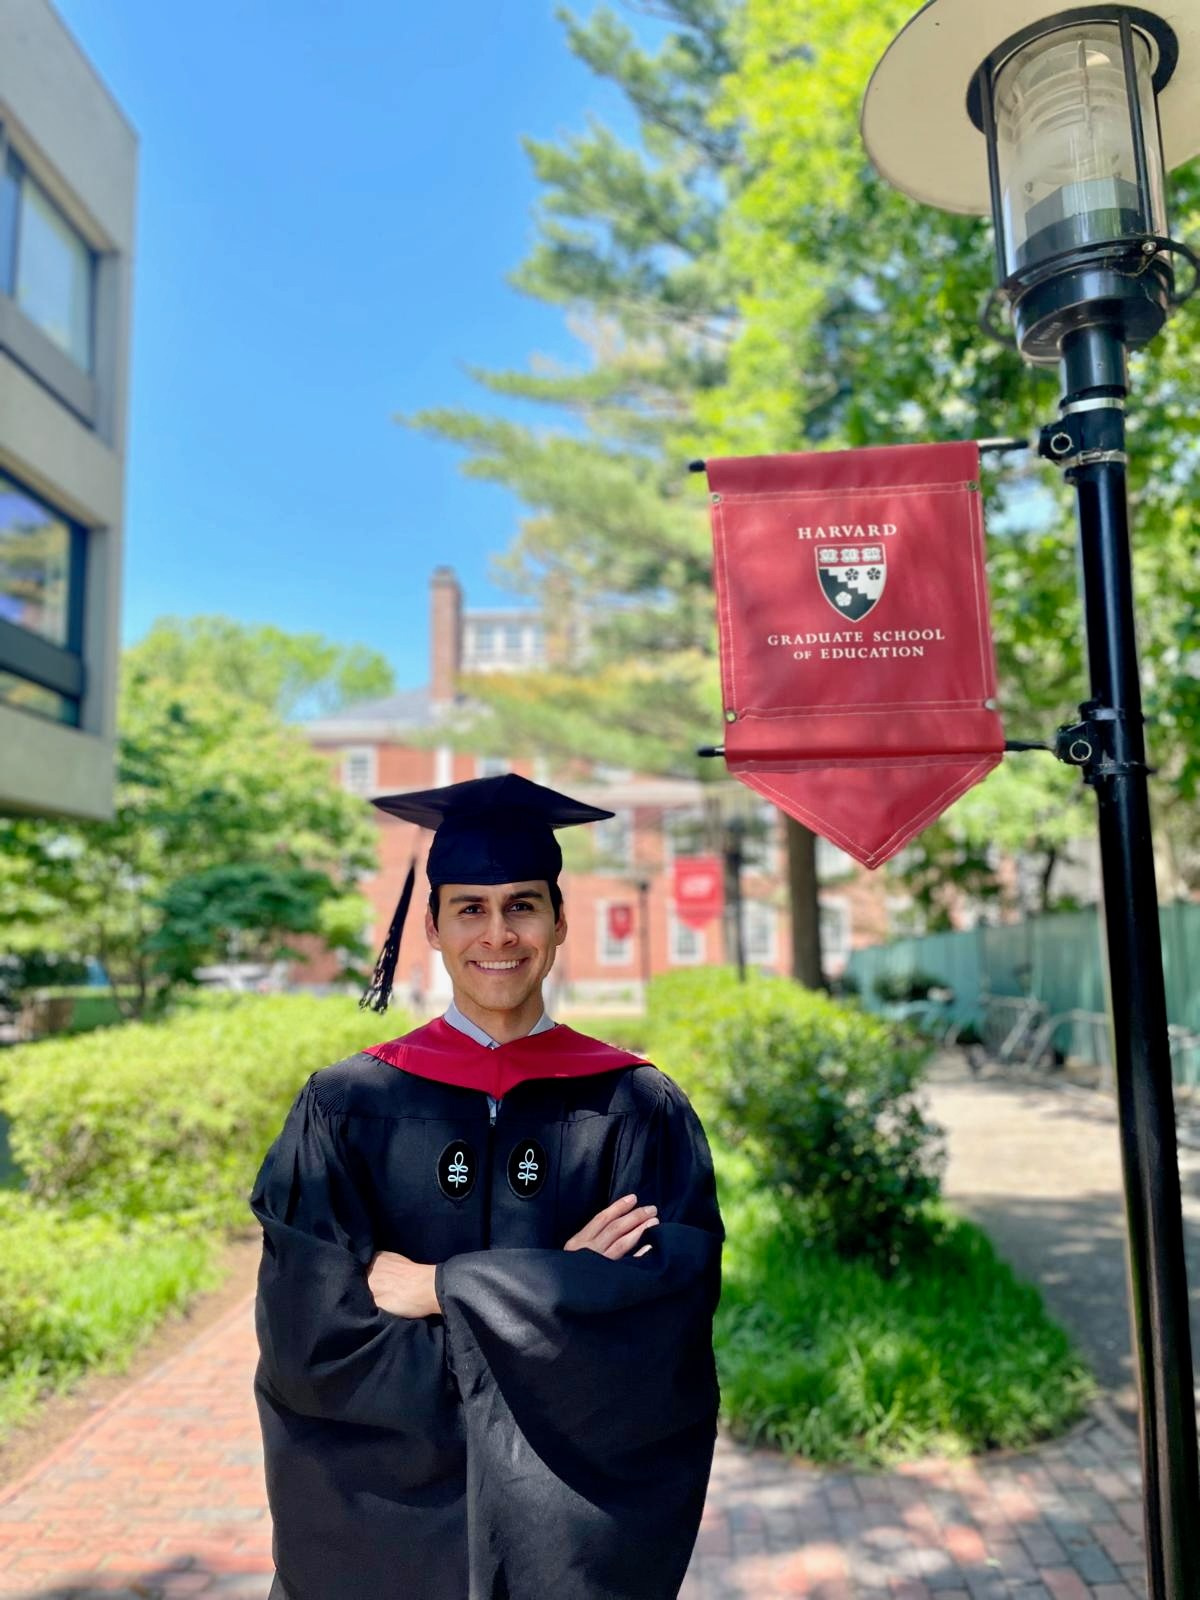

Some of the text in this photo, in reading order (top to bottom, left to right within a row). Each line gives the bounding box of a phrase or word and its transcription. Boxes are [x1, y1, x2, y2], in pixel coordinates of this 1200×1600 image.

[797, 523, 897, 539] HARVARD
[767, 629, 945, 646] GRADUATE SCHOOL
[793, 646, 925, 660] OF EDUCATION
